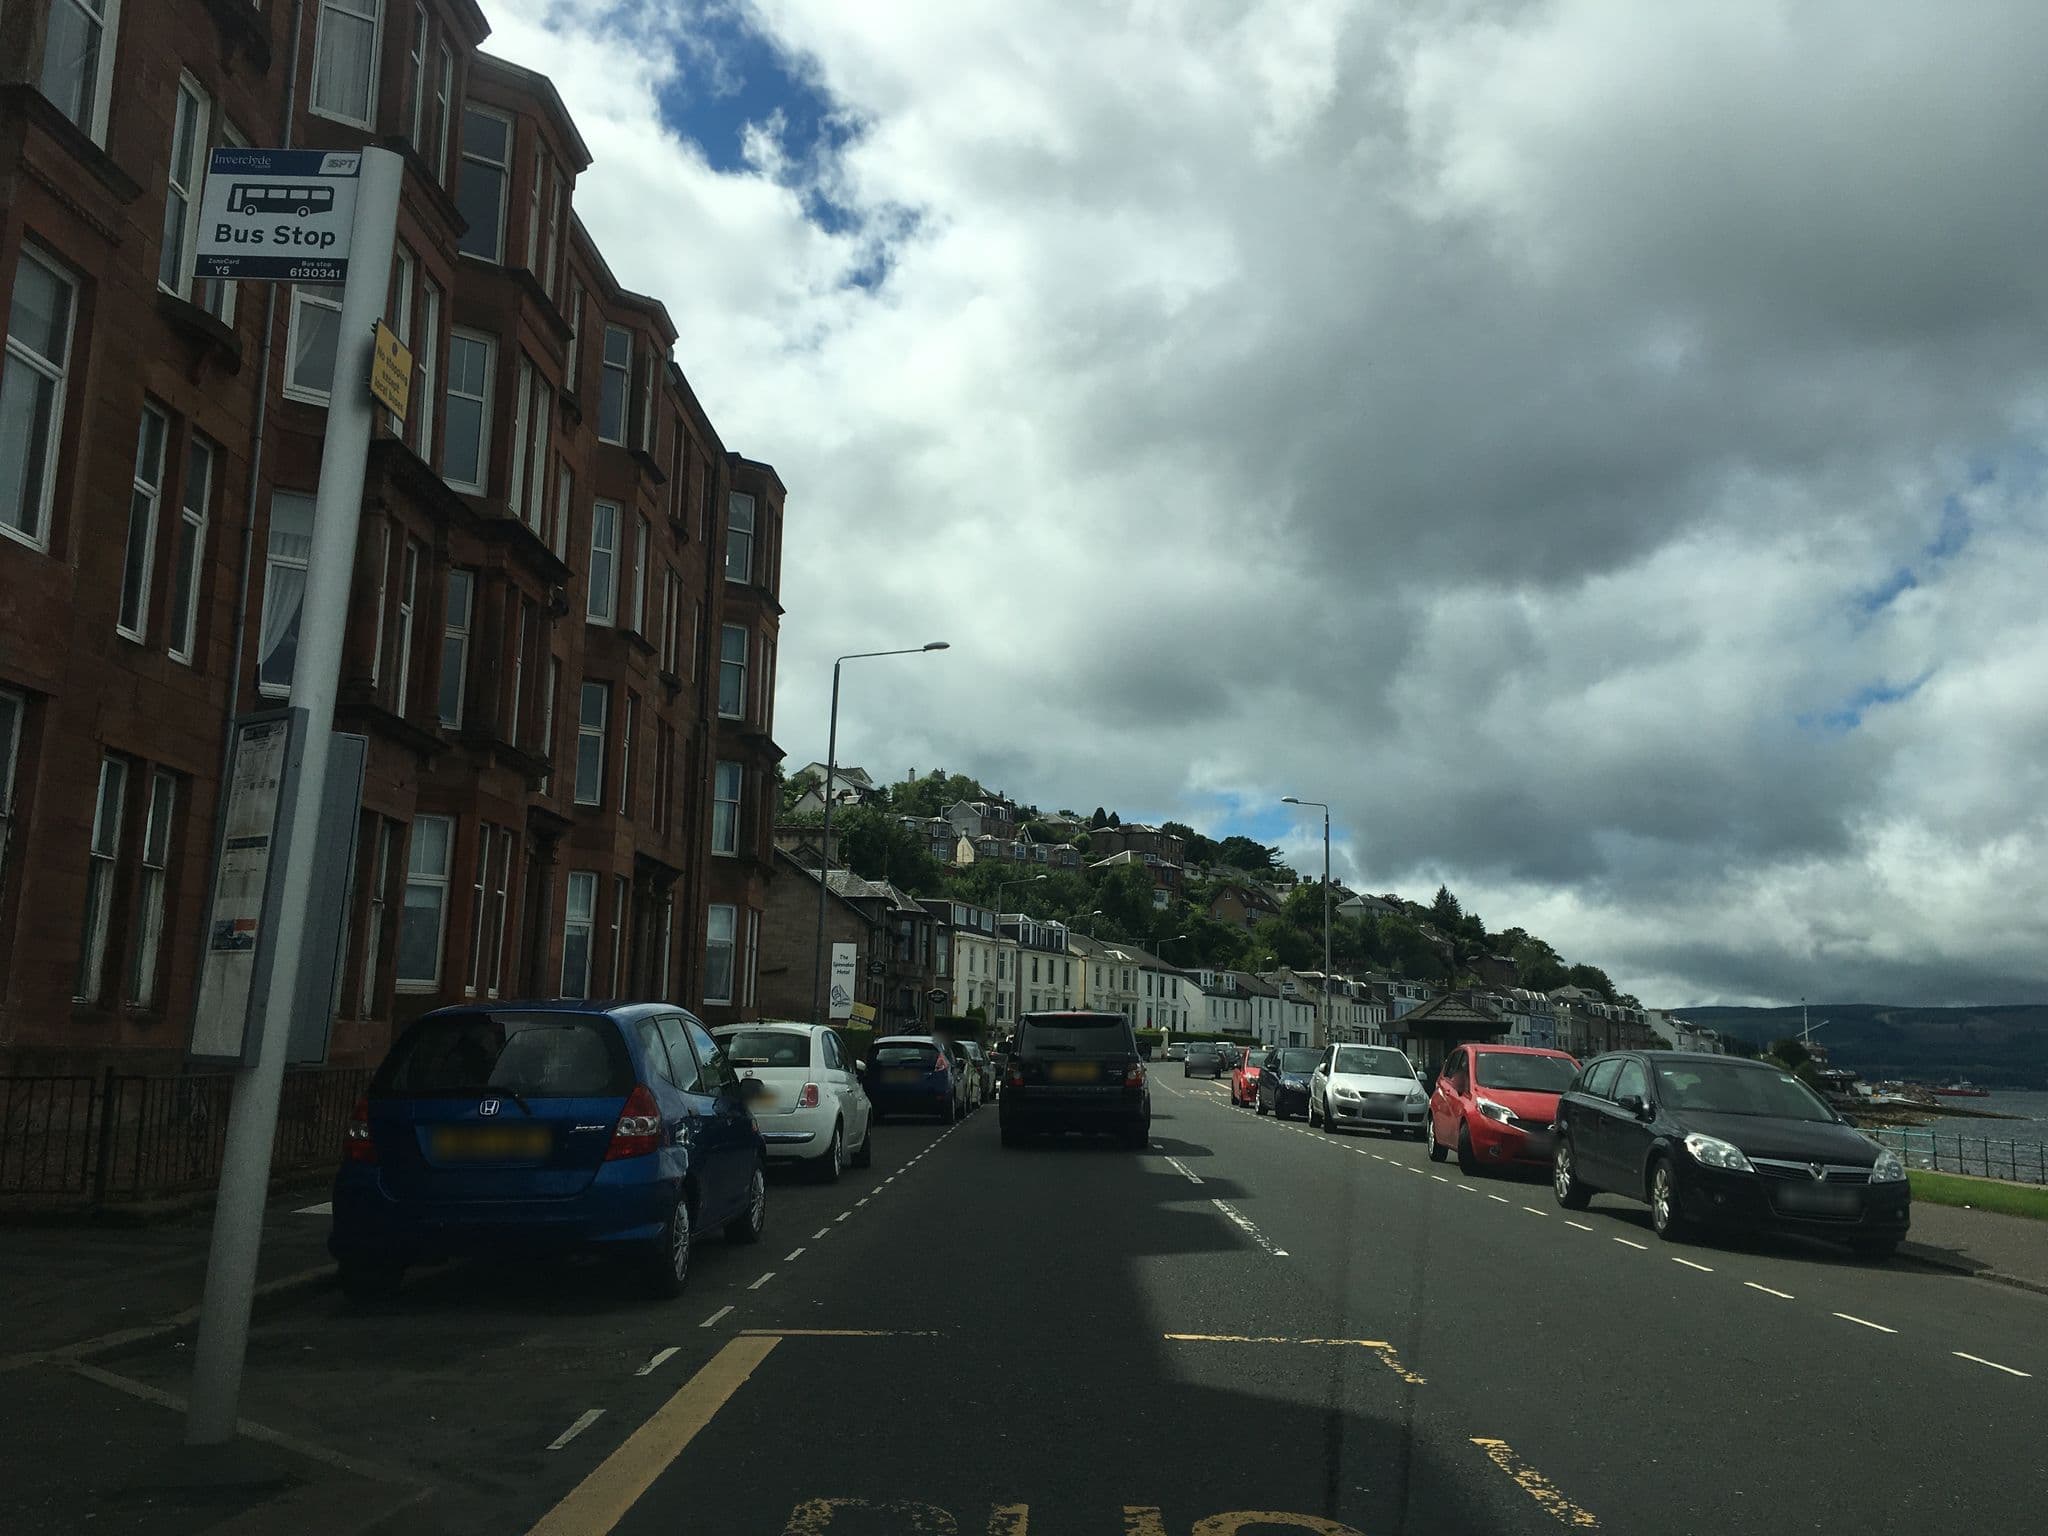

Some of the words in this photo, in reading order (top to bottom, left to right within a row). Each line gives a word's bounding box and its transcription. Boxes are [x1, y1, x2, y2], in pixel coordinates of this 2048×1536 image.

[214, 153, 272, 166] Inverclyde
[214, 223, 265, 244] Bus
[272, 225, 336, 249] Stop
[214, 266, 230, 275] Y5
[289, 267, 341, 278] 6130341
